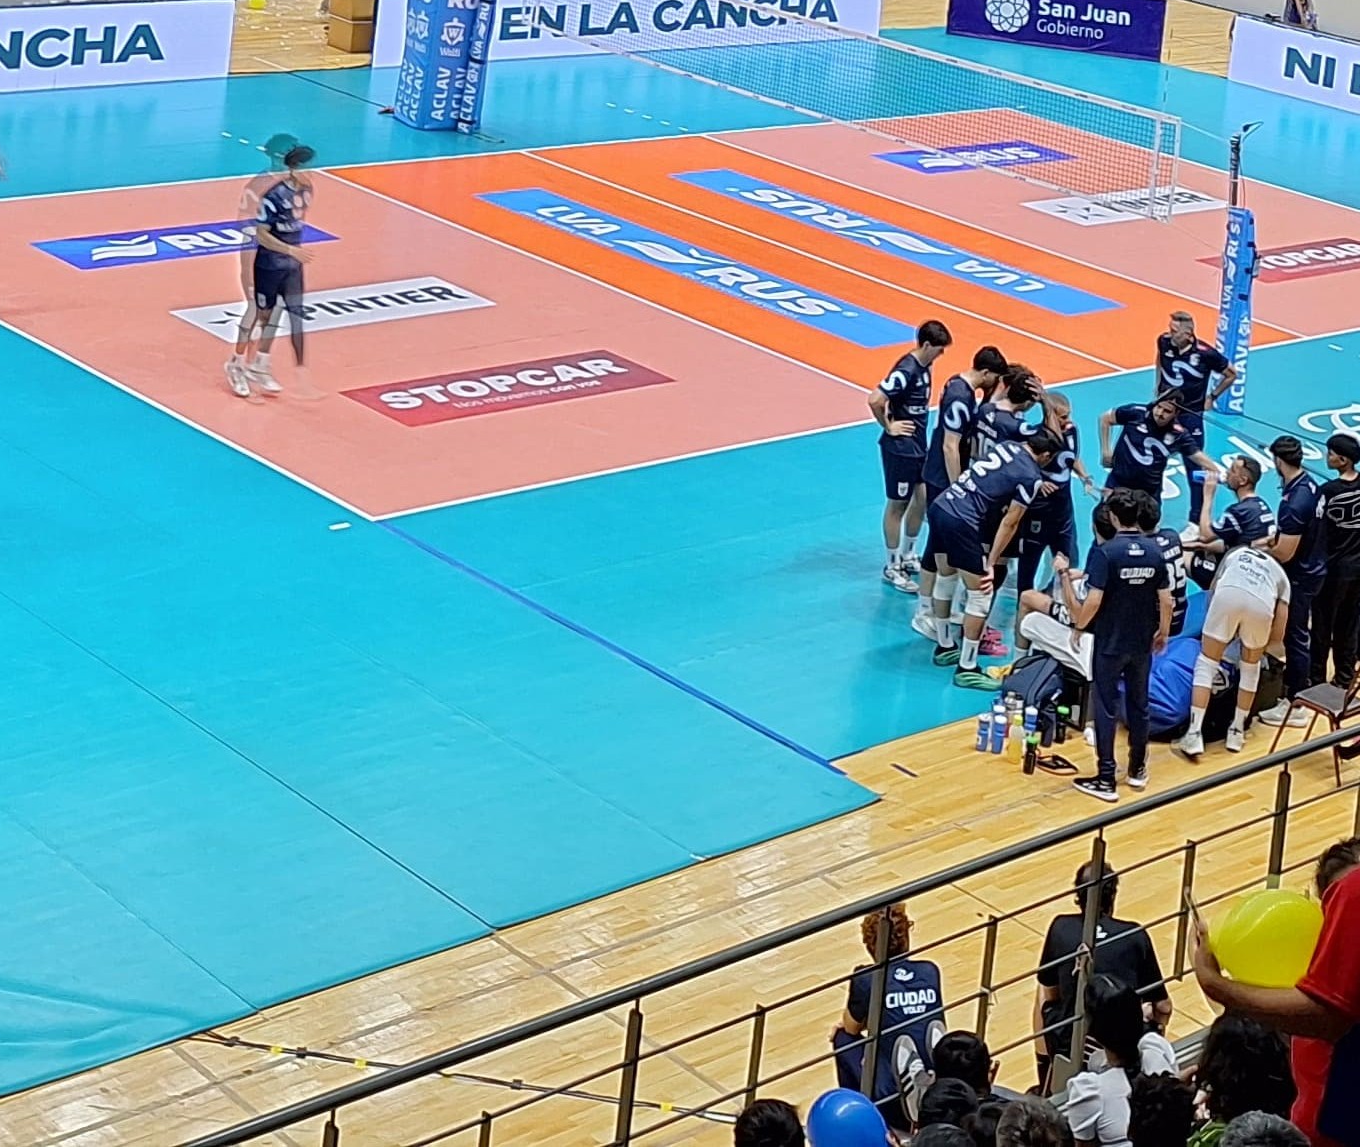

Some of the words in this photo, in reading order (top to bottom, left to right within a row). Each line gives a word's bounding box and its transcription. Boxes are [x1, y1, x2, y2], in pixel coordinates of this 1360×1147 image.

[499, 3, 568, 41] EN
[578, 1, 640, 38] LA
[1036, 18, 1105, 40] Gobierno
[1080, 3, 1131, 26] Juan
[457, 83, 477, 133] ACLAV
[471, 39, 484, 60] LVA
[1283, 46, 1337, 89] NI
[409, 66, 425, 122] ACLAV
[431, 67, 452, 121] ACLAV
[536, 205, 622, 236] LVA
[739, 188, 871, 230] RUS
[695, 265, 842, 317] RUS
[952, 259, 1047, 293] LVA
[296, 284, 470, 322] PINTIER
[1221, 284, 1232, 310] LVA
[378, 358, 630, 411] STOPCAR
[550, 383, 576, 393] con
[577, 379, 602, 389] vos
[1228, 346, 1248, 412] ACLAV
[1120, 567, 1155, 580] CIUDAD
[885, 988, 937, 1009] CIUDAD
[902, 1004, 927, 1015] VOLEY
